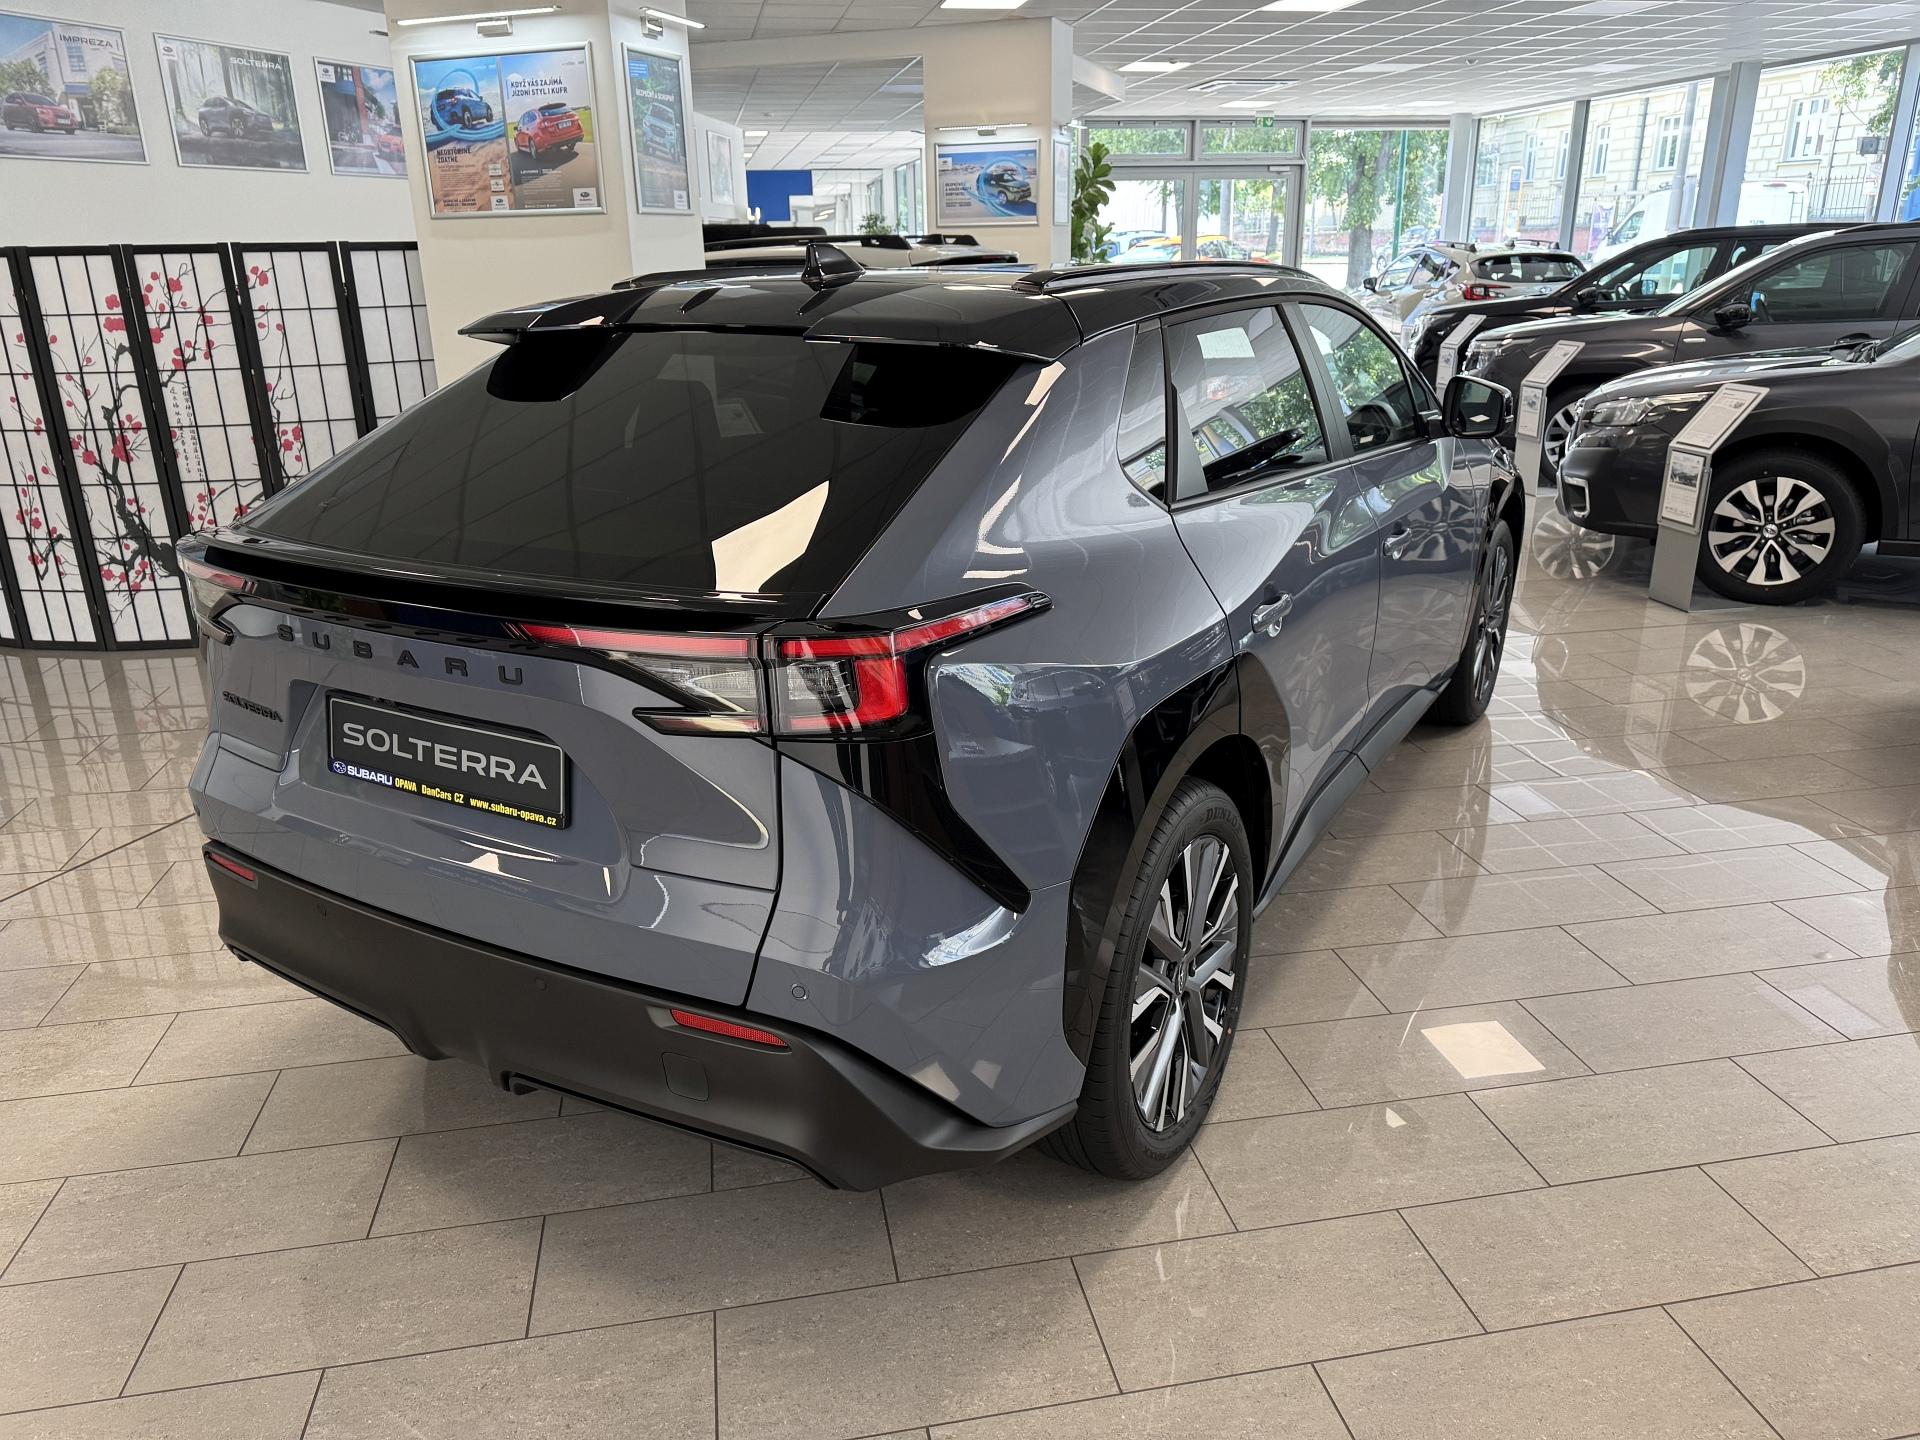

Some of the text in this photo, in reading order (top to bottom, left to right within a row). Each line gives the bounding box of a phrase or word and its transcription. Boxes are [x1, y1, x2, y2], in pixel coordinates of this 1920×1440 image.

[59, 33, 113, 48] IMPREZA
[229, 56, 282, 70] SOLTERRA
[511, 76, 563, 88] KDYŽ VÁS ZAJÍMÁ
[532, 88, 547, 96] STYL
[551, 86, 568, 94] KUFR
[276, 624, 523, 685] SUBARU
[343, 722, 547, 790] SOLTERRA
[347, 765, 557, 826] SUBARU OPAVA DanCars CZ www.subaru-opava.cz
